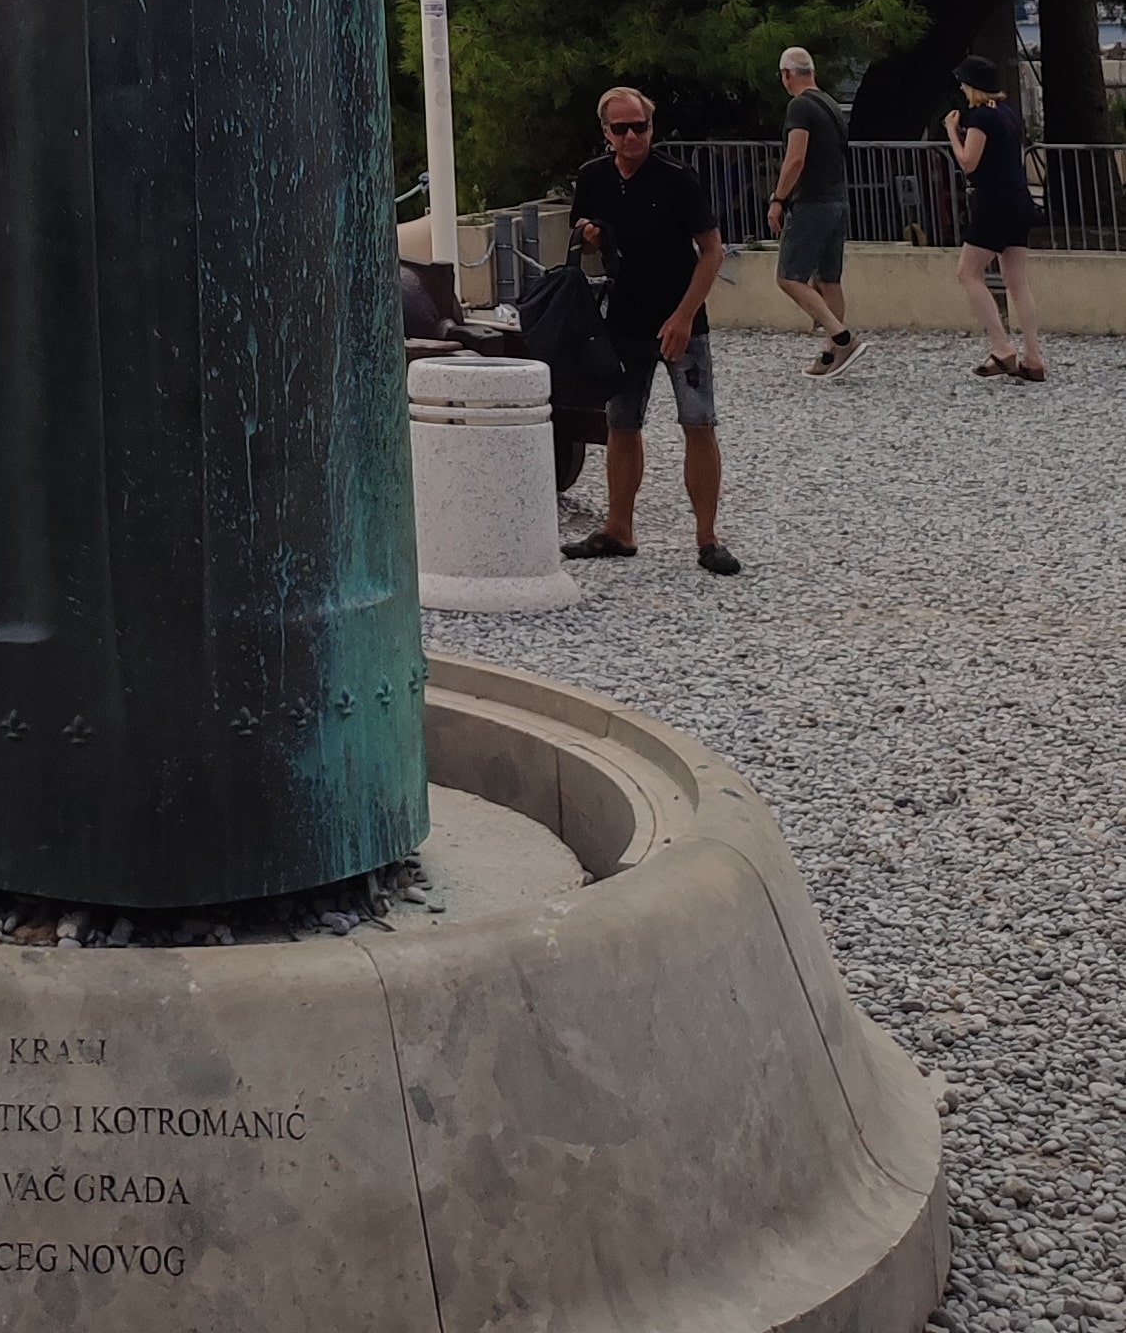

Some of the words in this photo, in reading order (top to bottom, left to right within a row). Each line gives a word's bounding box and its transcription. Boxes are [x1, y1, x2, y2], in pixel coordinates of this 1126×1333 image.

[73, 1105, 82, 1133] I
[92, 1104, 308, 1141] KOTROMANIĆ
[74, 1174, 191, 1206] GRADA
[68, 1243, 187, 1276] NOVOG
